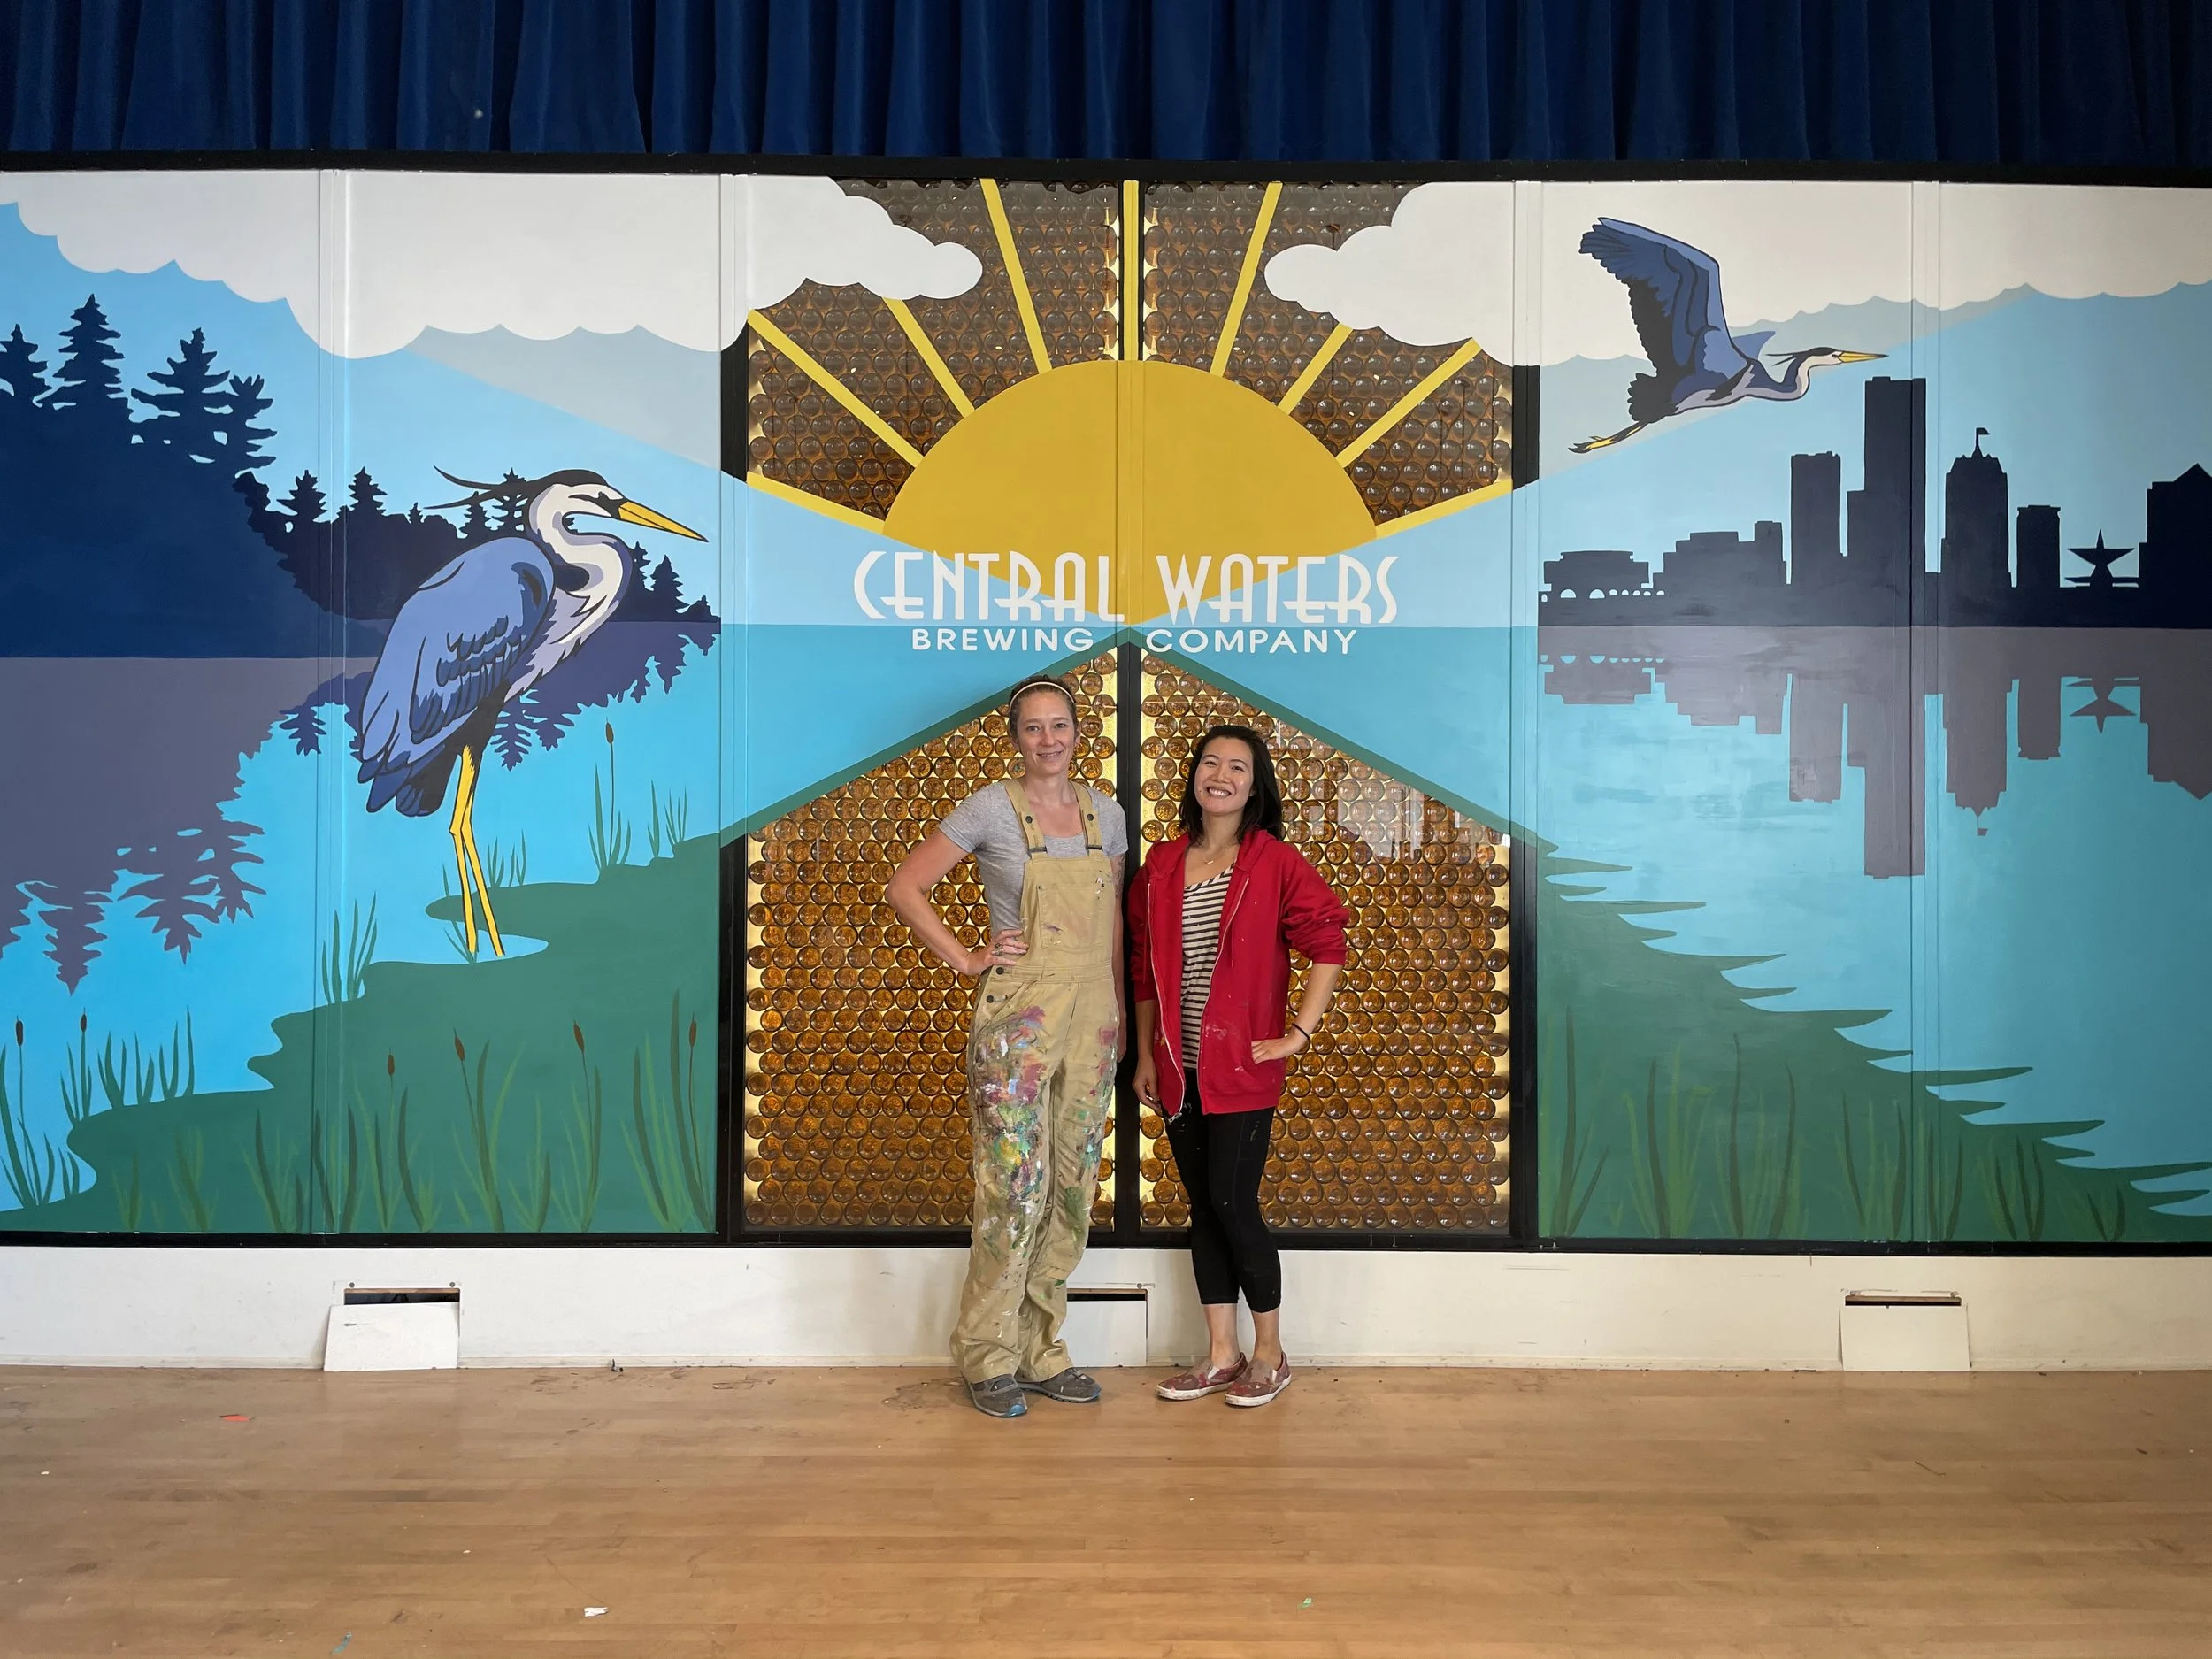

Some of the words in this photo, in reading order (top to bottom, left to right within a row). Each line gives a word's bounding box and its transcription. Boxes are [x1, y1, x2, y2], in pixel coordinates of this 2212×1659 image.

[854, 551, 1125, 623] CENTRAL
[1156, 553, 1400, 626] WATERS
[911, 628, 1094, 652] BREWING
[1146, 629, 1357, 655] COMPANY
